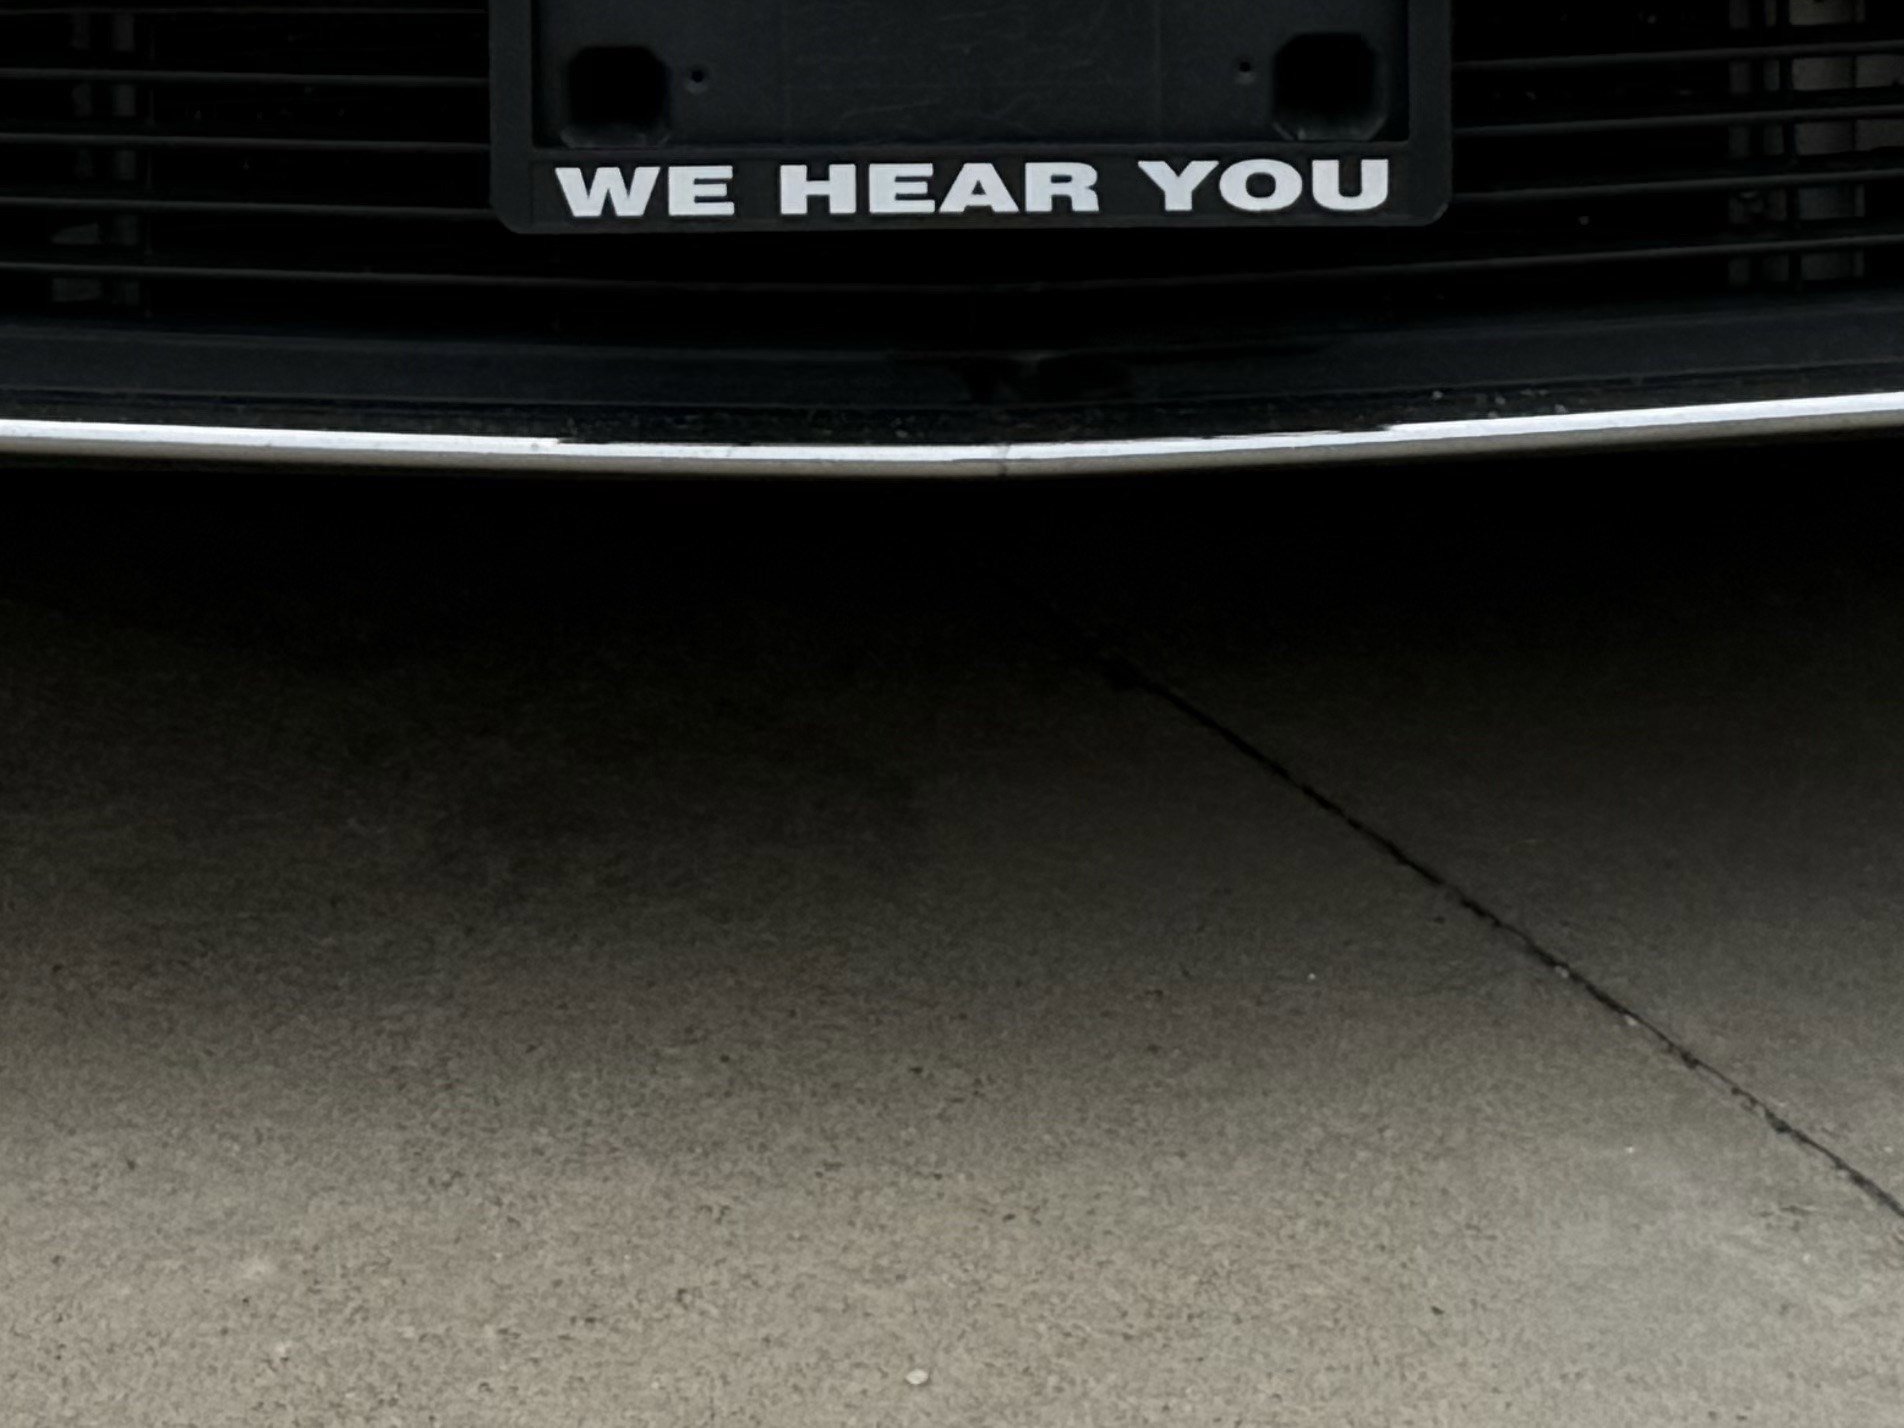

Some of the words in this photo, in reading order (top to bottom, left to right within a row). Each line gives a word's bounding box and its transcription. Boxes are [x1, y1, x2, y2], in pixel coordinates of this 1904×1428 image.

[553, 164, 736, 219] WE
[778, 160, 1101, 216] HEAR
[1136, 157, 1390, 213] YOU
